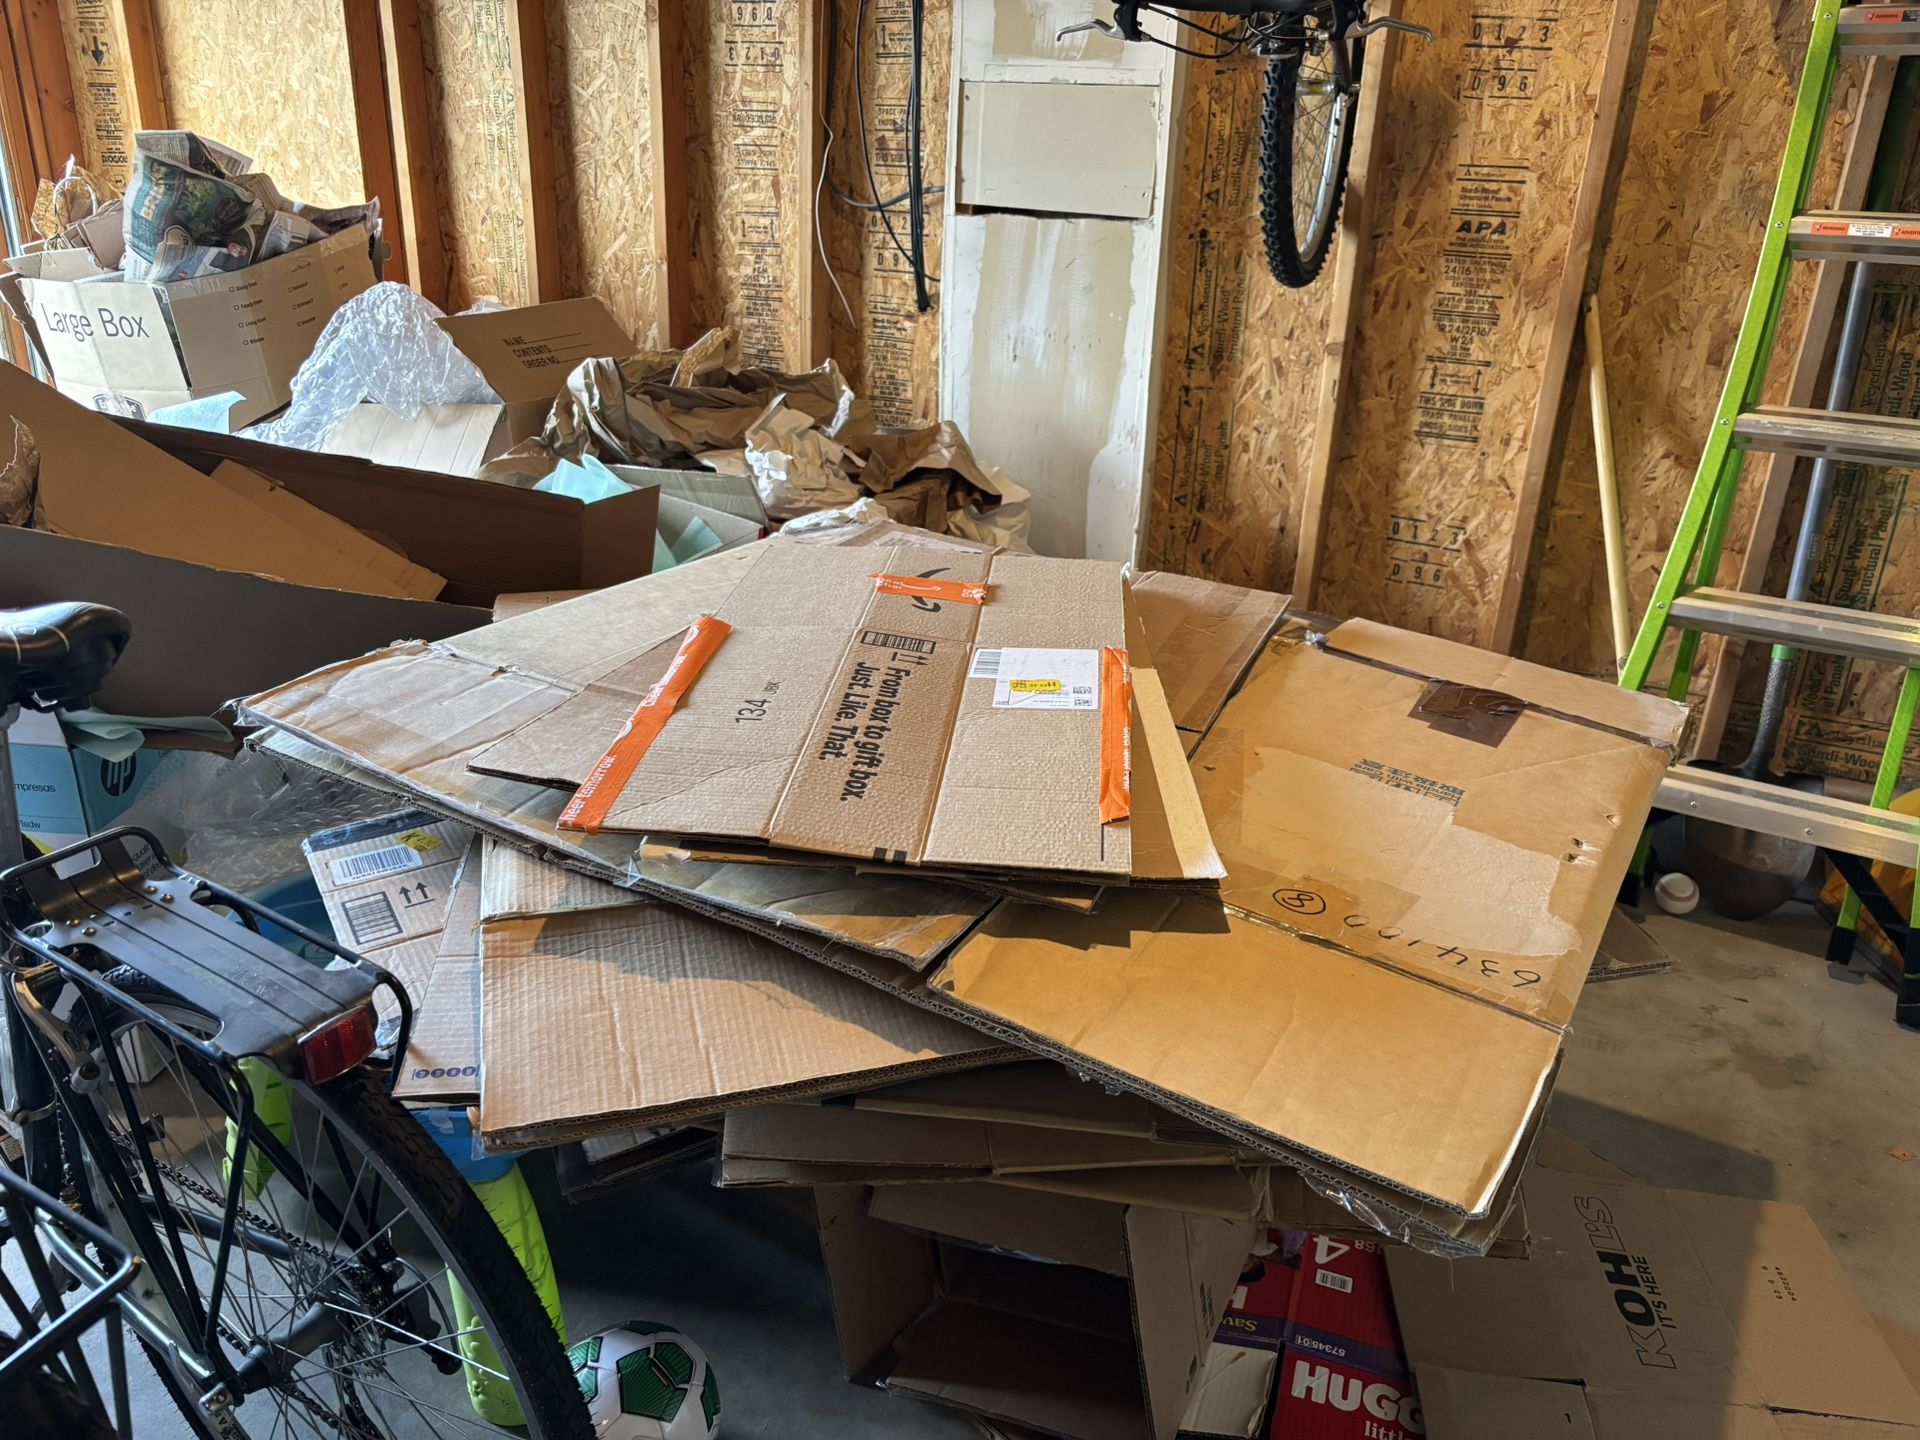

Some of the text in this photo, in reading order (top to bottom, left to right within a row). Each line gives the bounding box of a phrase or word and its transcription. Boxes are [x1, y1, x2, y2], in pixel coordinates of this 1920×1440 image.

[1456, 219, 1507, 236] APA
[1443, 265, 1471, 276] 24/16
[1196, 268, 1212, 339] Weyerhaeuser
[41, 303, 150, 342] Large Box
[502, 336, 526, 346] NAME
[512, 345, 552, 358] CONTENTS
[1439, 397, 1458, 409] SIDE
[1460, 400, 1485, 410] DOWN
[1854, 544, 1883, 605] Structural
[735, 699, 772, 723] 134
[819, 662, 881, 761] Just. Like. That.
[840, 666, 911, 802] From box to gift box.
[575, 753, 618, 799] tomorrow.
[1354, 764, 1462, 800] Handle with Care
[1312, 1235, 1350, 1264] 4
[1631, 1255, 1677, 1329] IT'S HERE
